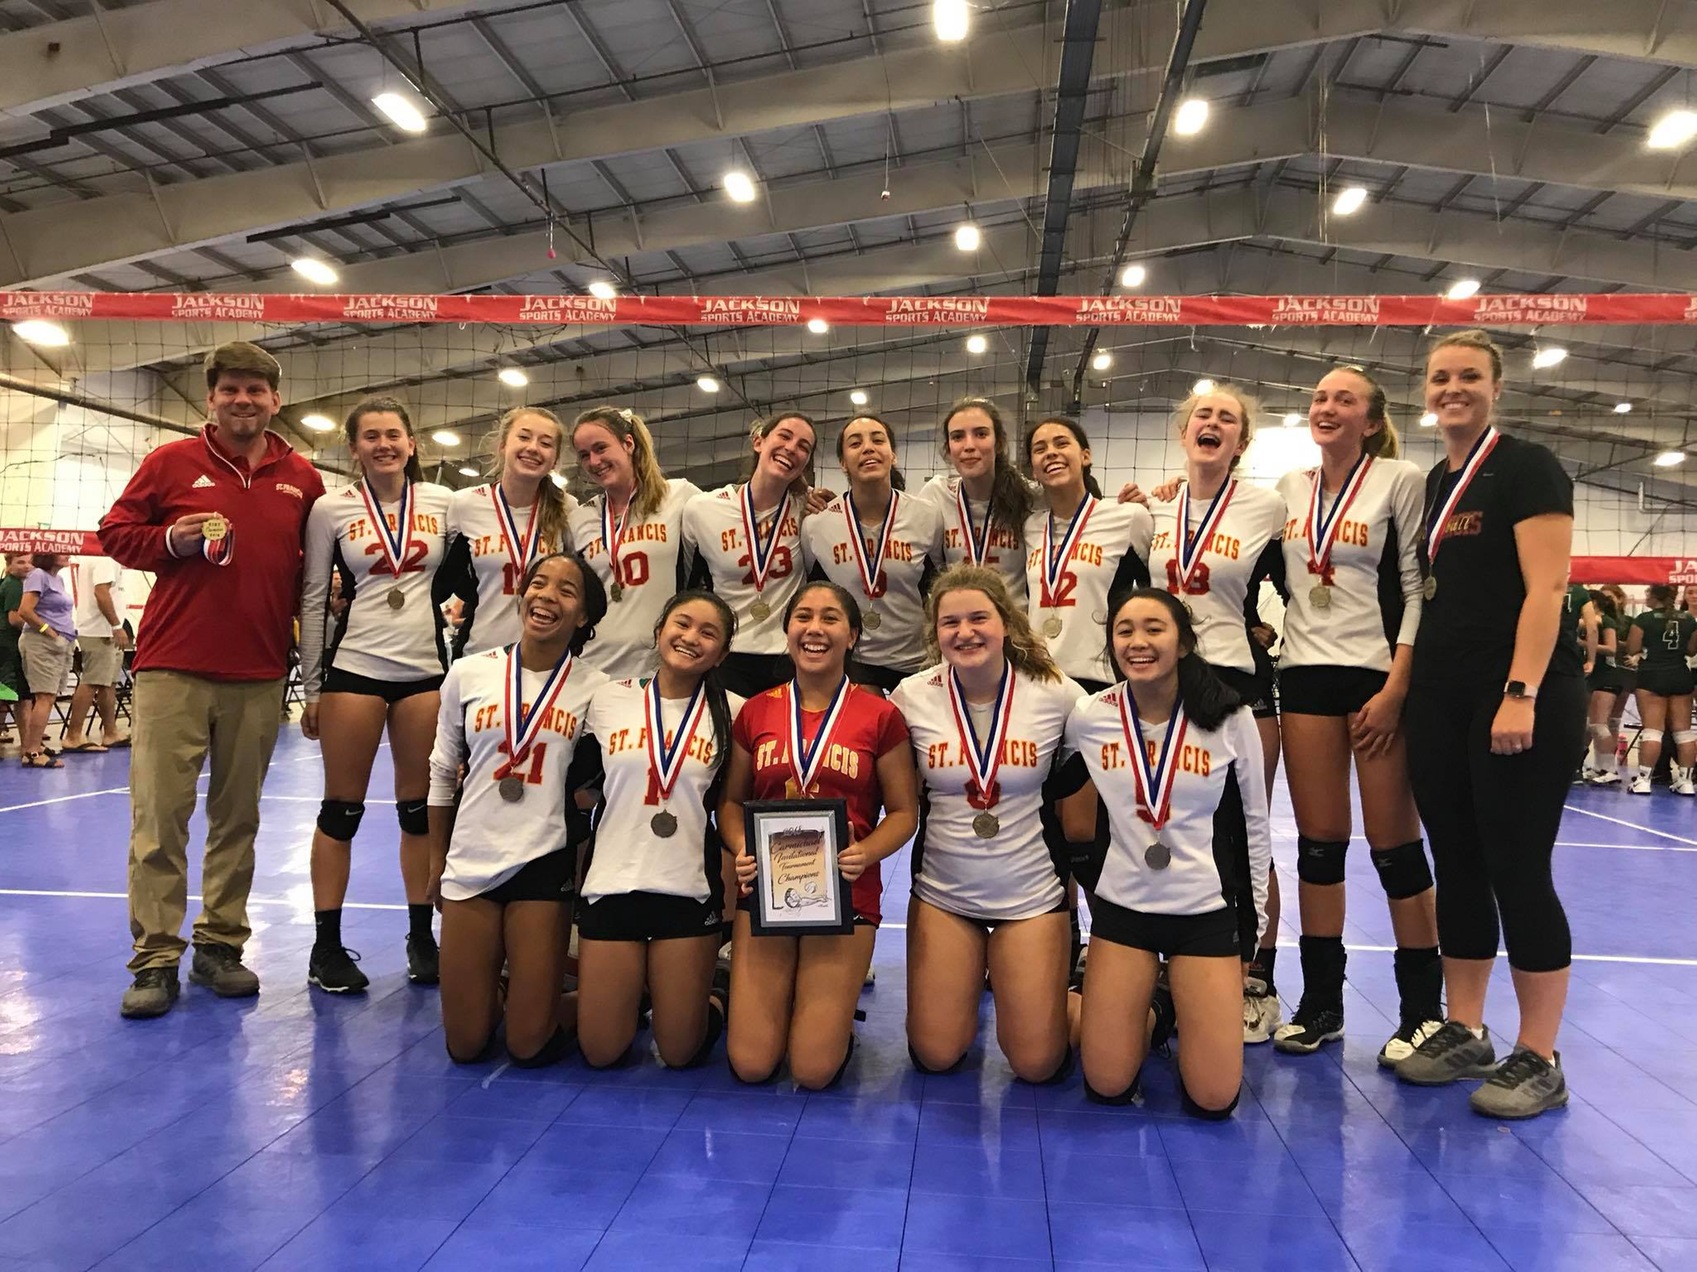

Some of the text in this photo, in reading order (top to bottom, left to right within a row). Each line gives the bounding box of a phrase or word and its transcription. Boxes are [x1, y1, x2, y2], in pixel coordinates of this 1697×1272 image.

[3, 293, 94, 307] JACKSON
[172, 296, 264, 310] JACKSON
[343, 297, 438, 310] JACKSON
[519, 296, 617, 311] JACKSON
[700, 299, 800, 313] JACKSON
[886, 299, 988, 313] JACKSON
[1075, 298, 1181, 313] JACKSON
[1272, 298, 1381, 313] JACKSON
[1474, 297, 1587, 312] JACKSON
[51, 305, 93, 317] ACADEMY
[171, 308, 264, 319] SPORTS ACADEMY
[343, 309, 437, 319] SPORTS ACADEMY
[519, 310, 616, 321] SPORTS ACADEMY
[700, 311, 800, 322] SPORTS ACADEMY
[886, 311, 987, 322] SPORTS ACADEMY
[1075, 310, 1181, 321] SPORTS ACADEMY
[1271, 310, 1380, 322] SPORTS ACADEMY
[1474, 309, 1587, 321] SPORTS ACADEMY
[349, 519, 372, 540] ST.
[721, 528, 742, 552] ST.
[944, 528, 962, 549] ST.
[34, 541, 82, 553] ACADEMY
[474, 535, 496, 557] ST.
[364, 540, 429, 575] 22
[833, 543, 853, 565] ST.
[738, 545, 794, 585] 23
[1662, 620, 1680, 650] 4
[475, 704, 502, 733] ST.
[608, 728, 633, 756] ST.
[928, 742, 953, 769] ST.
[1101, 742, 1126, 771] ST.
[778, 872, 820, 885] Champions
